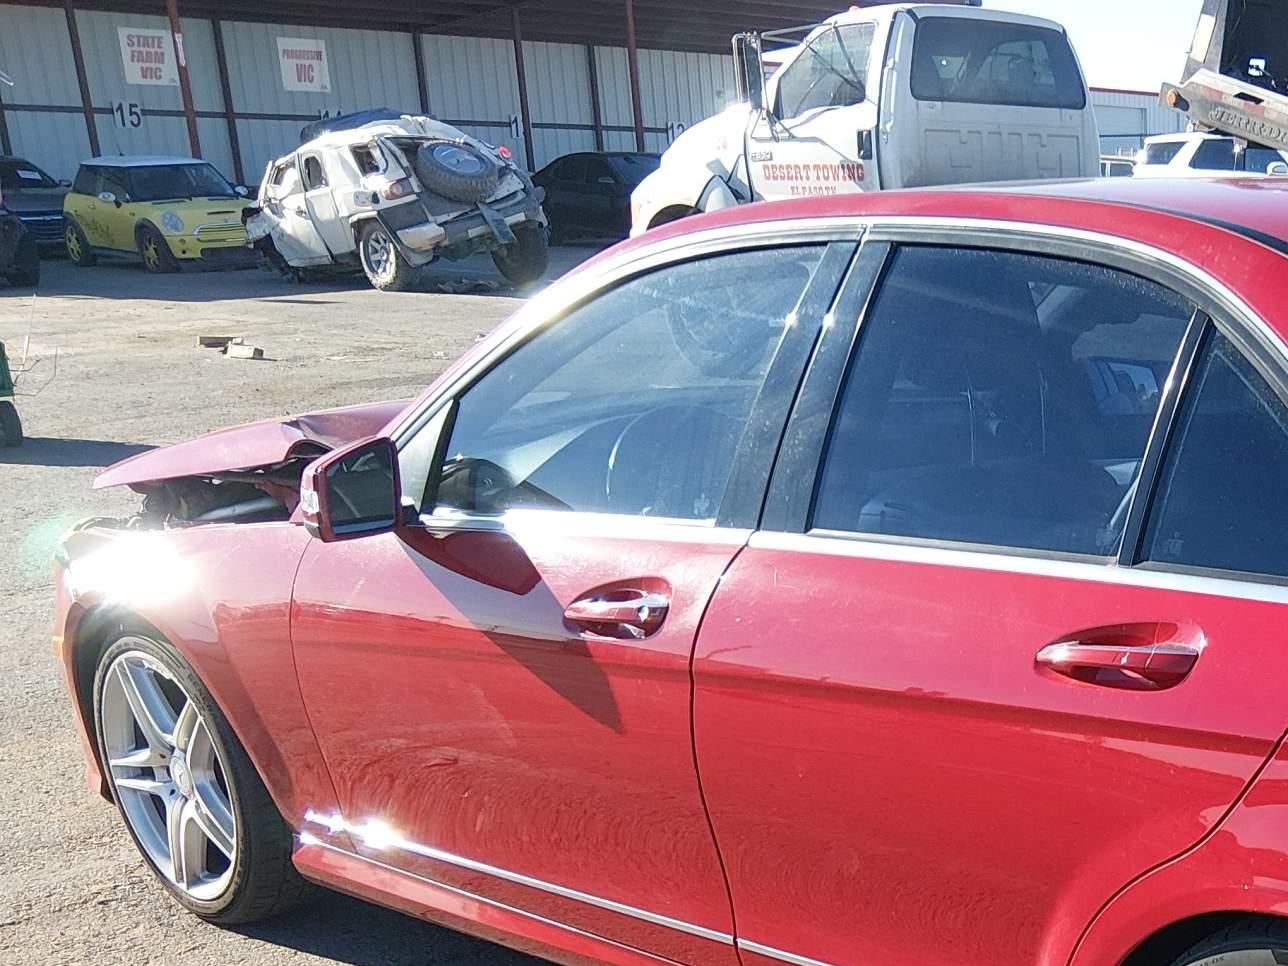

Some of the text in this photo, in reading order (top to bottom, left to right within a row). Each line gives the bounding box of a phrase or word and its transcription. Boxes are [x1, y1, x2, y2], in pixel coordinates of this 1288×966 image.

[126, 34, 164, 49] STATE
[130, 50, 165, 65] FARM
[282, 48, 324, 61] PROGRESSIVE
[140, 66, 162, 80] VIC
[295, 63, 315, 83] VIC
[115, 102, 142, 128] 15
[762, 163, 865, 182] DESERT TOWING
